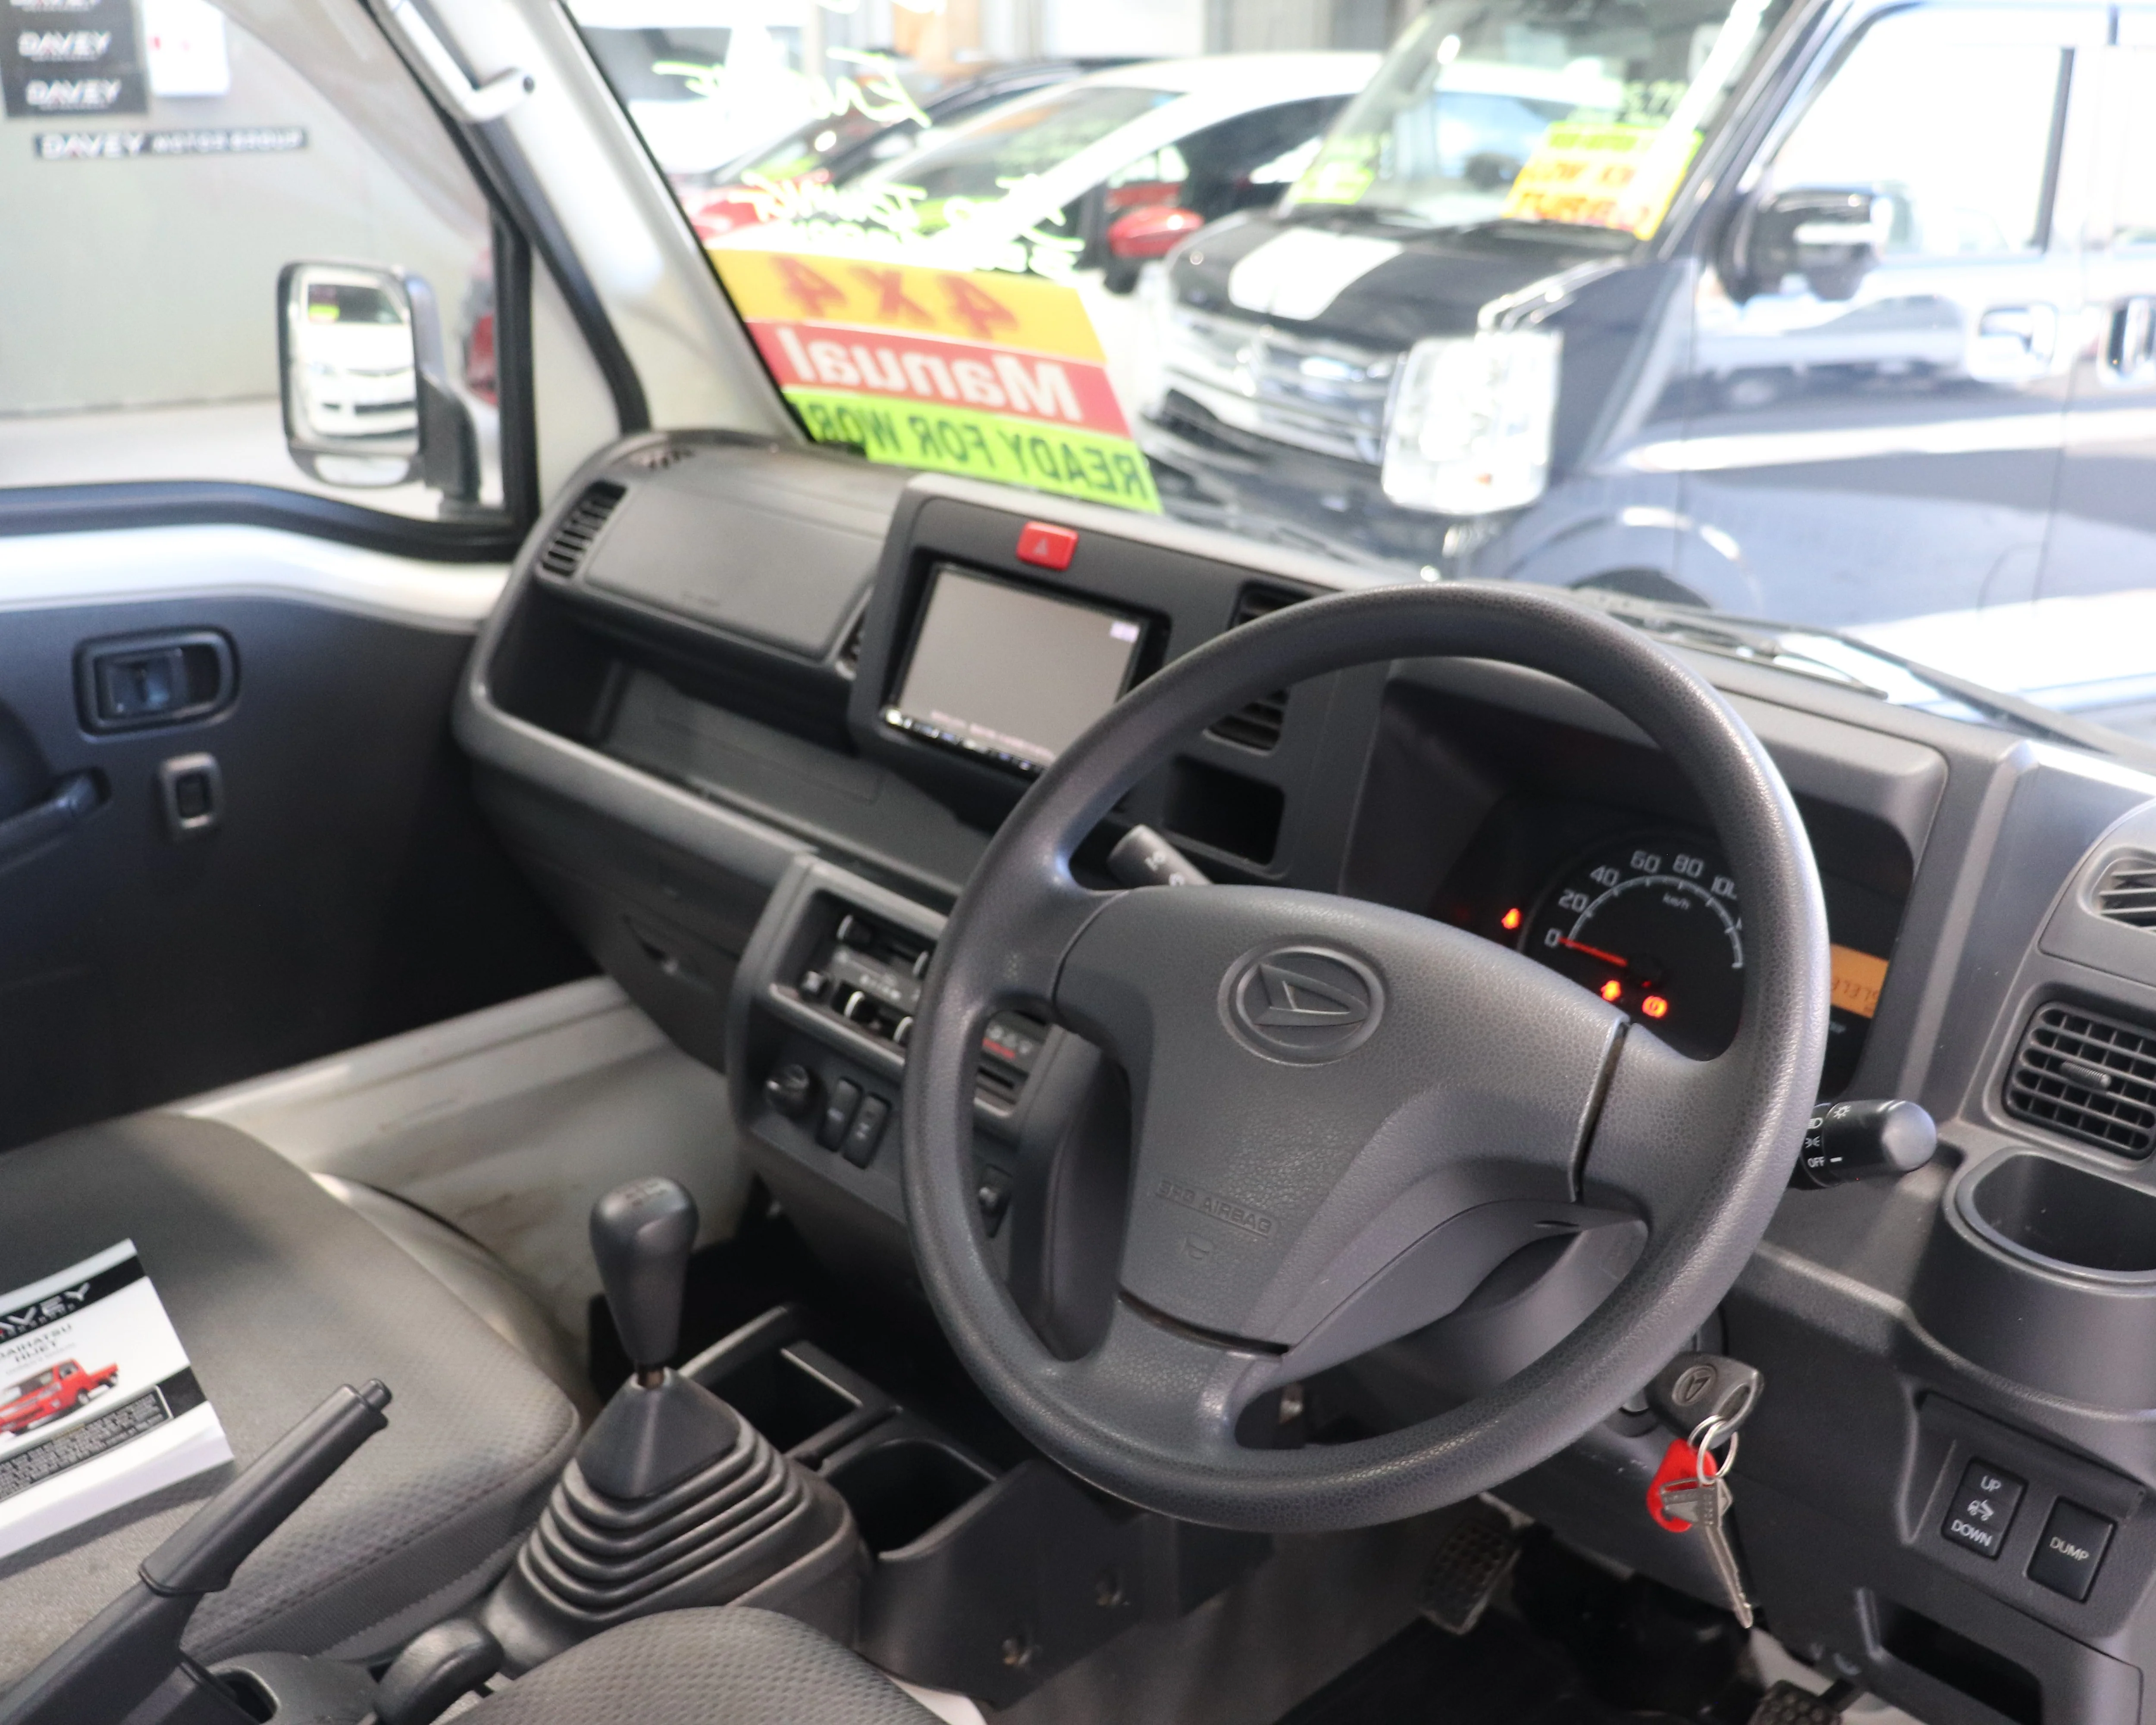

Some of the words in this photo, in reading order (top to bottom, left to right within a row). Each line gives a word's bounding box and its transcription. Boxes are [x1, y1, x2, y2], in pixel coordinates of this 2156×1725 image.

[18, 30, 112, 57] DAVEY
[26, 79, 122, 105] DAVEY
[42, 133, 146, 158] DAVEY
[1630, 850, 1661, 874] 60
[1672, 853, 1704, 878] 80
[1590, 865, 1620, 888] 40
[1558, 888, 1589, 913] 20
[1544, 927, 1562, 948] 0
[1807, 1156, 1825, 1168] OFF
[1201, 1196, 1272, 1234] AIRBAG
[0, 1282, 91, 1336] AVEY
[1981, 1475, 2002, 1492] UP
[1950, 1519, 1992, 1547] DOWN
[2049, 1537, 2089, 1561] DUMP
